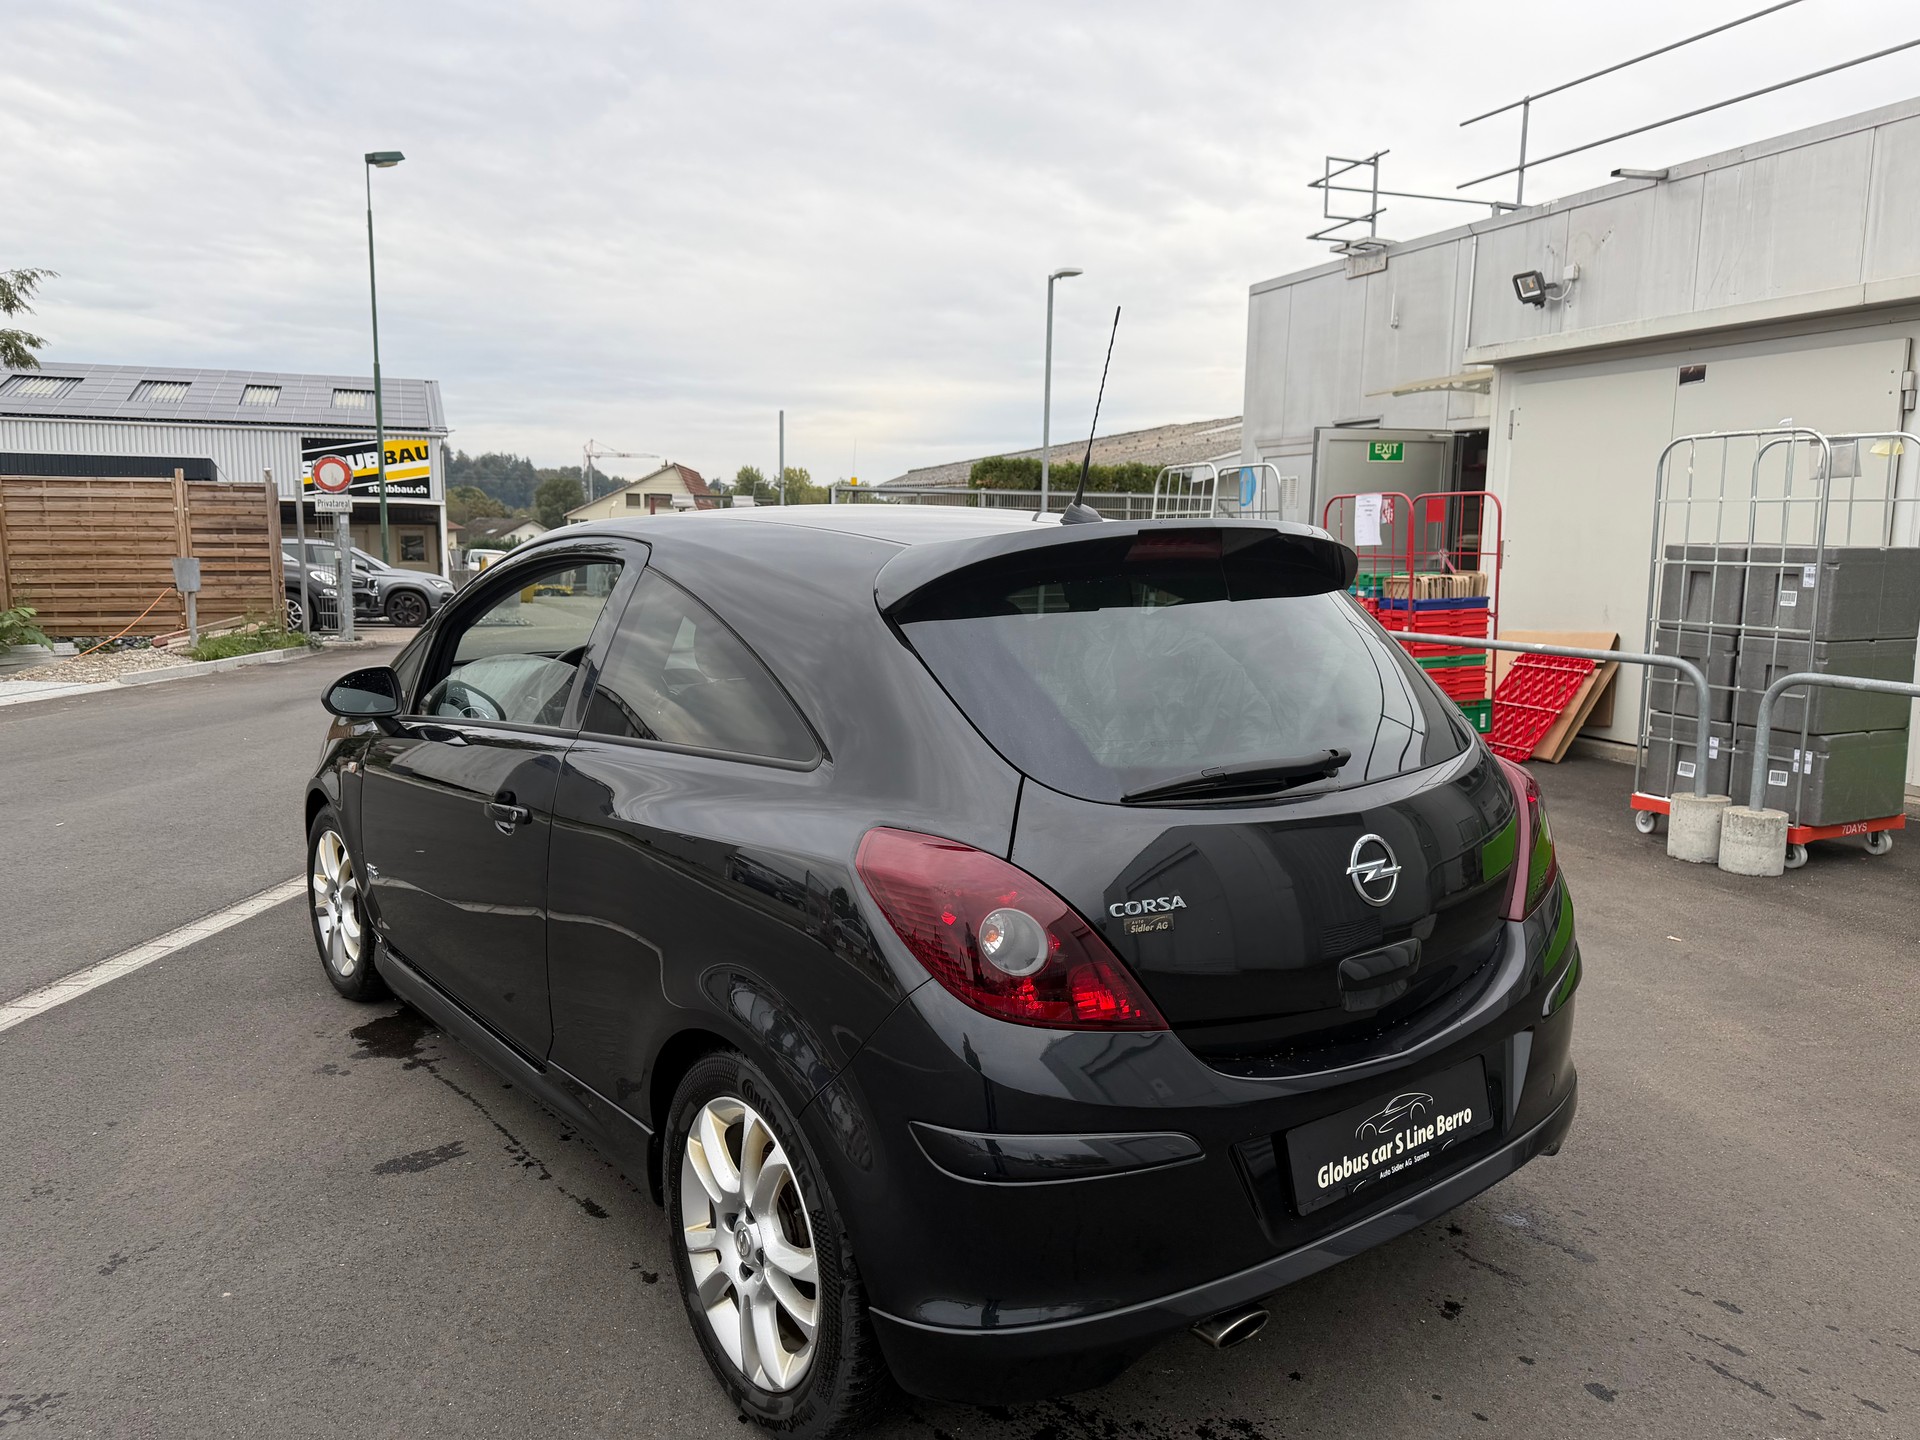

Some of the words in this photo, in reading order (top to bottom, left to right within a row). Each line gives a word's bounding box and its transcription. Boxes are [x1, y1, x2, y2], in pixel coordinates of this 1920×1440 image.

[1375, 443, 1398, 454] EXIT
[317, 499, 350, 509] Privatareal
[1841, 822, 1867, 835] 7DAYS
[1109, 895, 1187, 917] CORSA
[1130, 923, 1154, 934] Sidler
[1156, 921, 1169, 931] AG
[1317, 1152, 1369, 1188] Globus
[1371, 1141, 1394, 1165] car
[1395, 1132, 1404, 1155] S
[1406, 1125, 1434, 1150] Line
[1436, 1108, 1472, 1136] Berro
[1380, 1169, 1391, 1179] Auto
[1391, 1163, 1404, 1174] Sidler
[1405, 1158, 1412, 1167] AG
